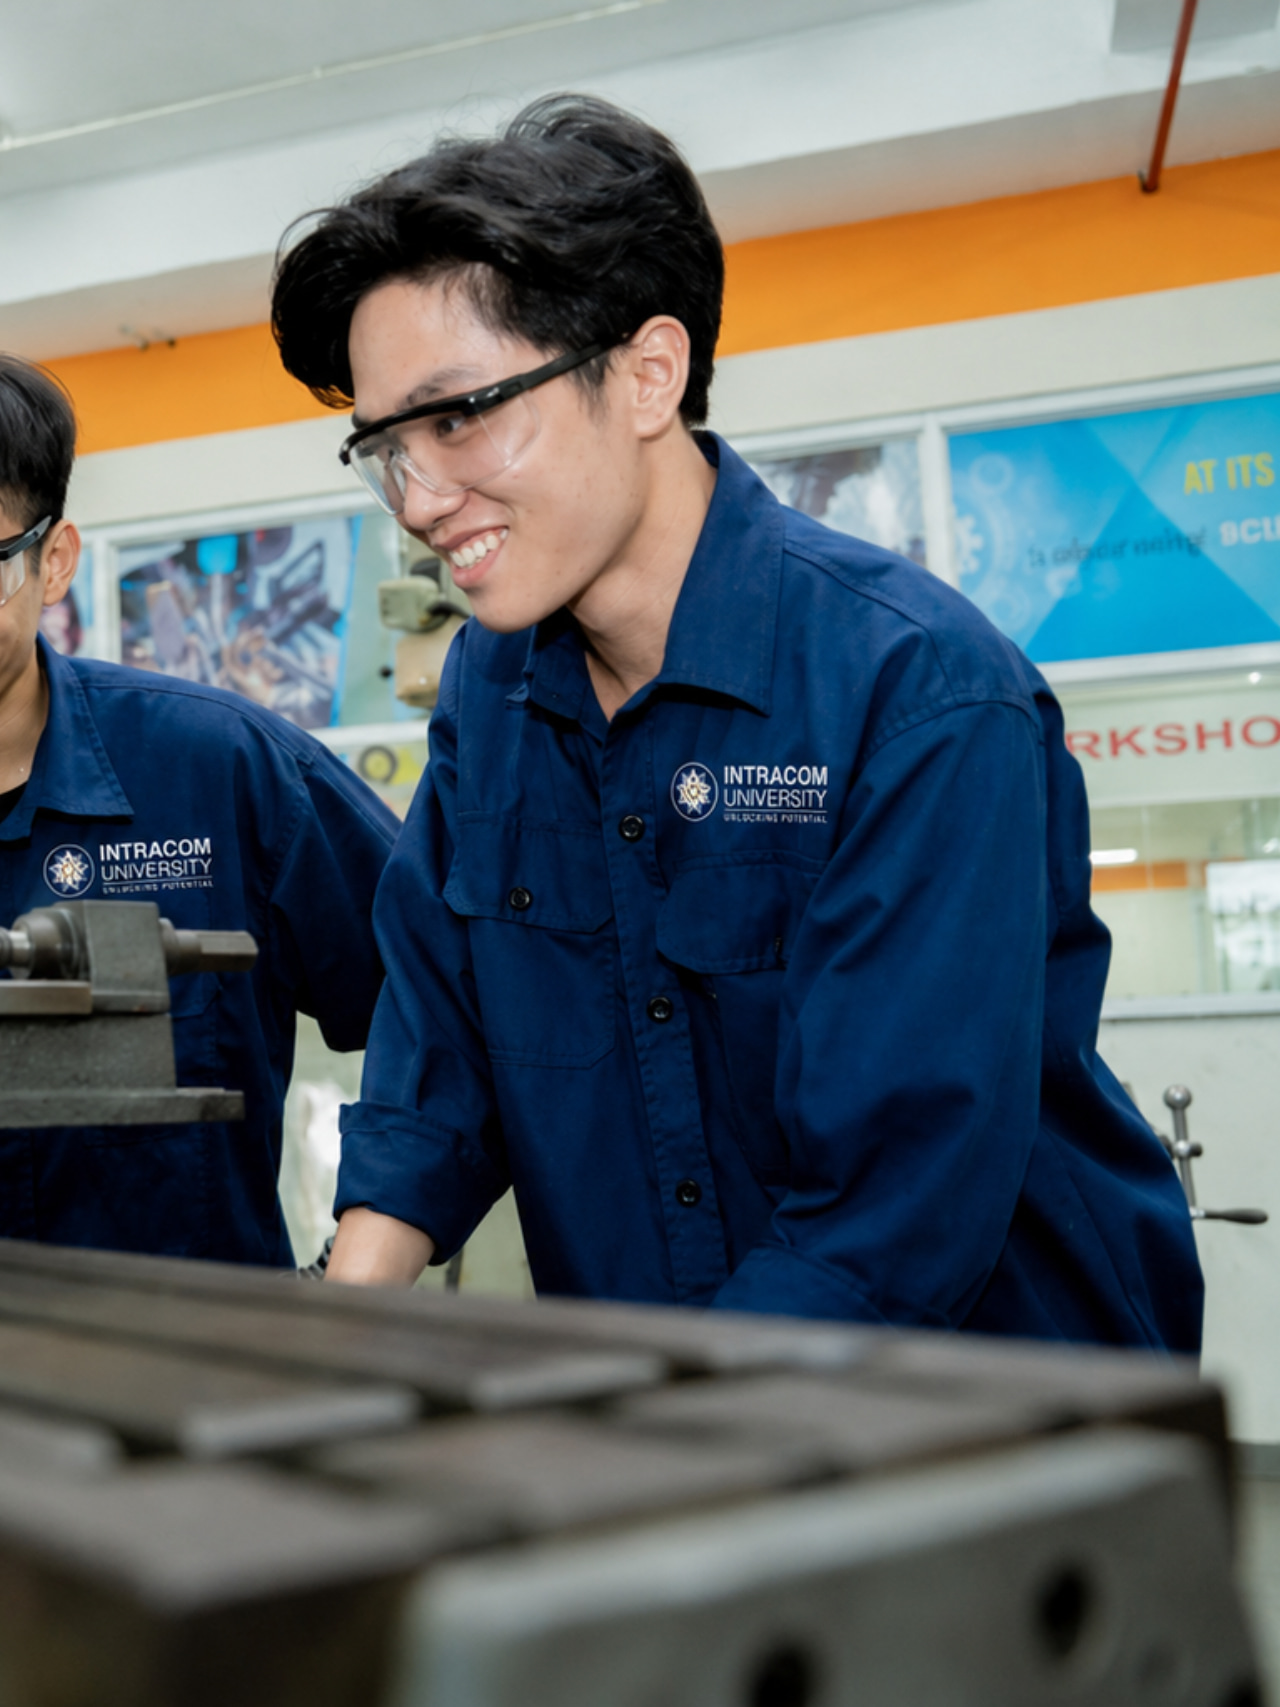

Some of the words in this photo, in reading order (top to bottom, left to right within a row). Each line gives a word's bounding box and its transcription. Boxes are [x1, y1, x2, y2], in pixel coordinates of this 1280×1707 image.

[1183, 459, 1218, 495] AT
[1226, 452, 1275, 490] ITS
[723, 765, 828, 785] INTRACOM
[723, 788, 828, 809] UNIVERSITY
[99, 837, 212, 862] INTRACOM
[101, 857, 213, 881] UNIVERSITY
